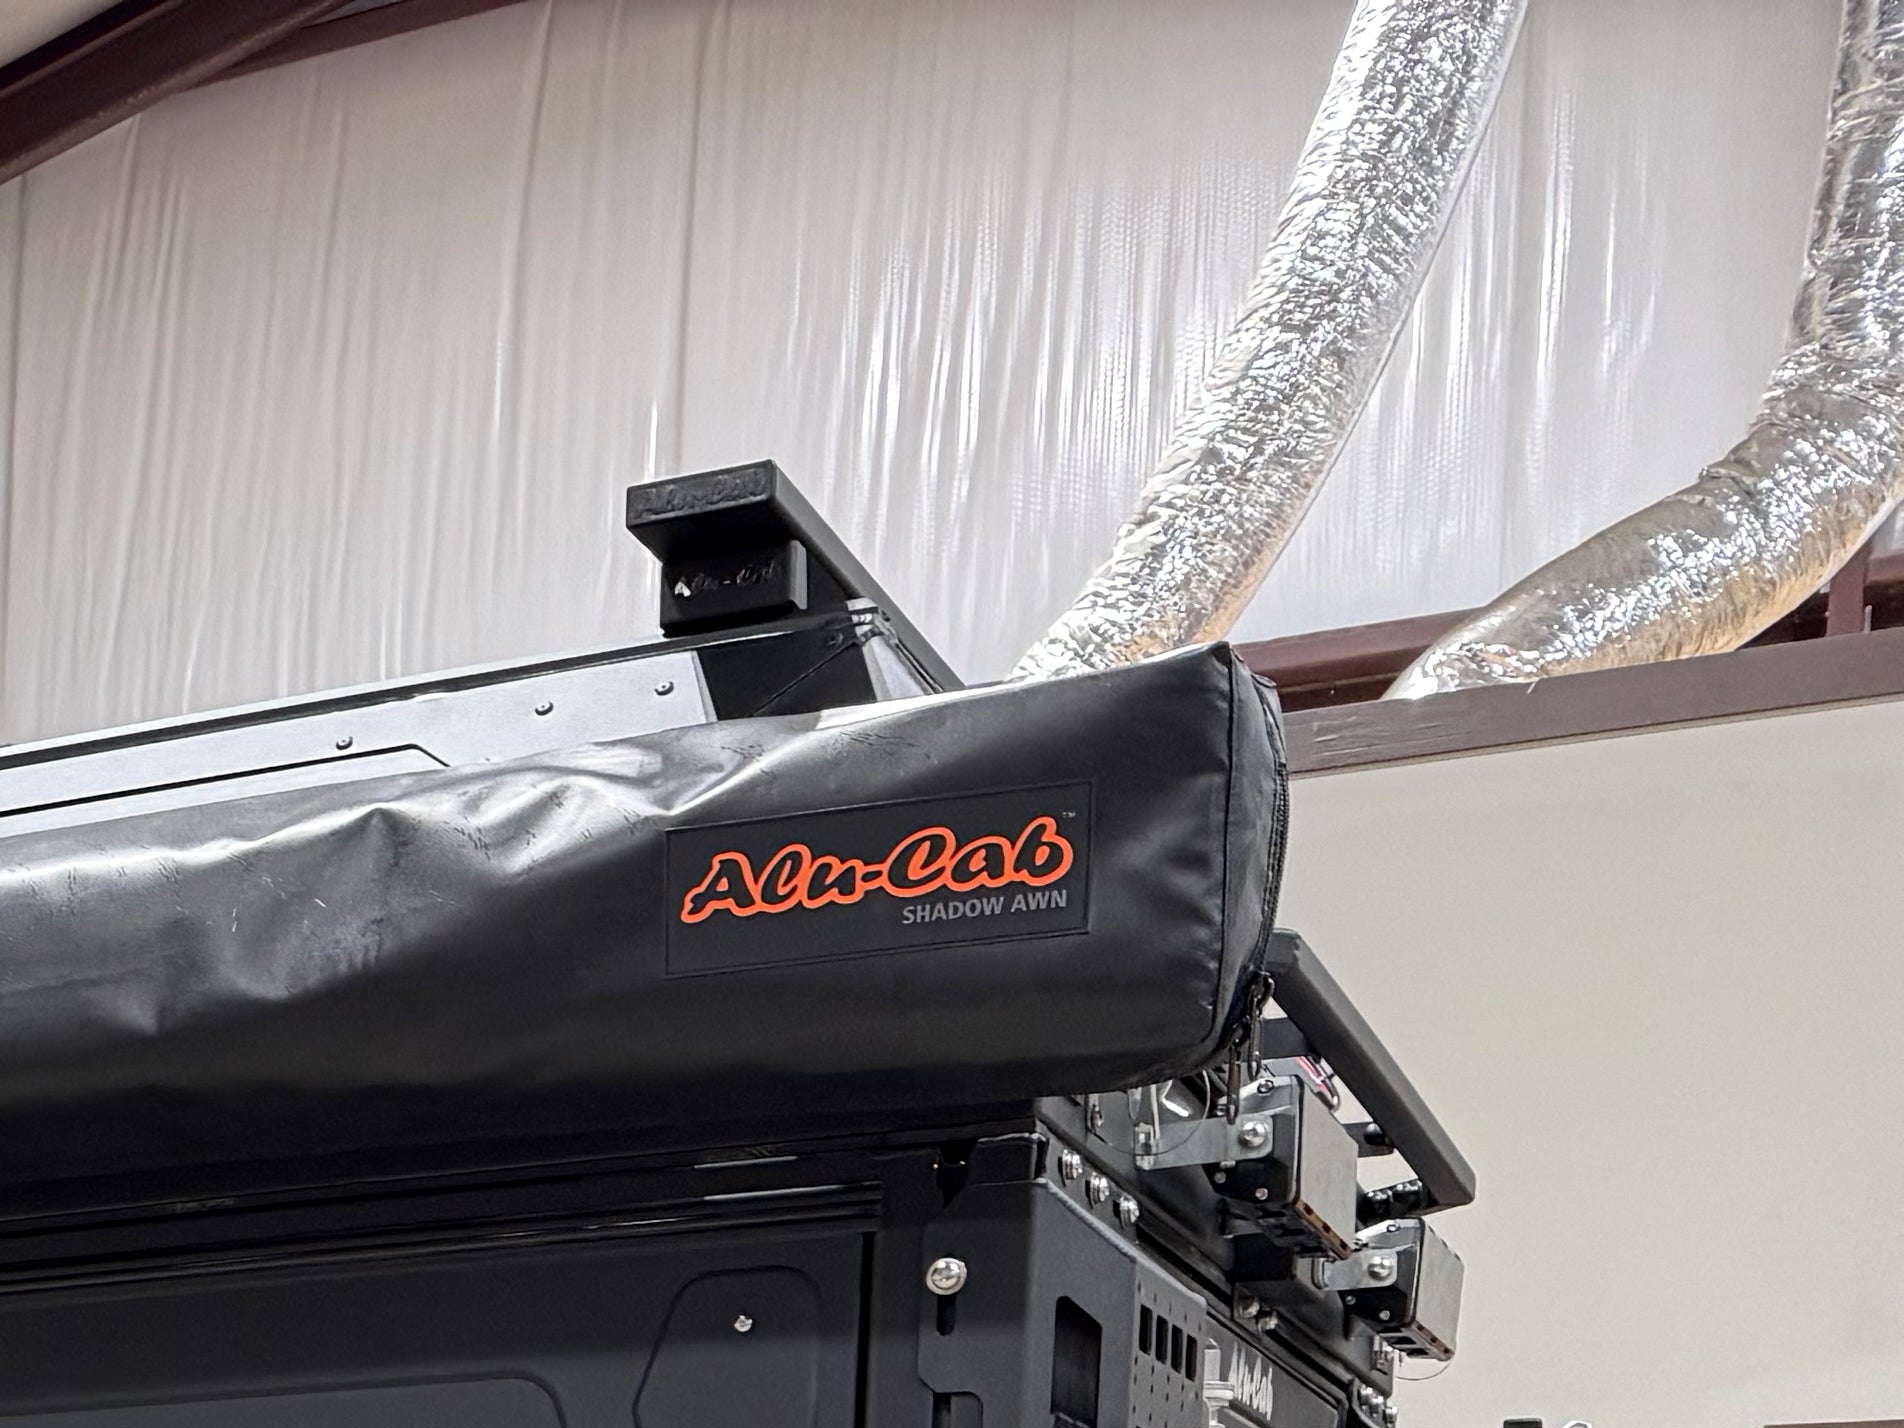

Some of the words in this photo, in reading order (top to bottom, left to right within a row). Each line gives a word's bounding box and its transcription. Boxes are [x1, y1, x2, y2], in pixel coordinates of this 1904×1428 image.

[681, 815, 1073, 924] Alu-Cab
[901, 895, 1004, 926] SHADOW
[1010, 889, 1068, 914] AWN
